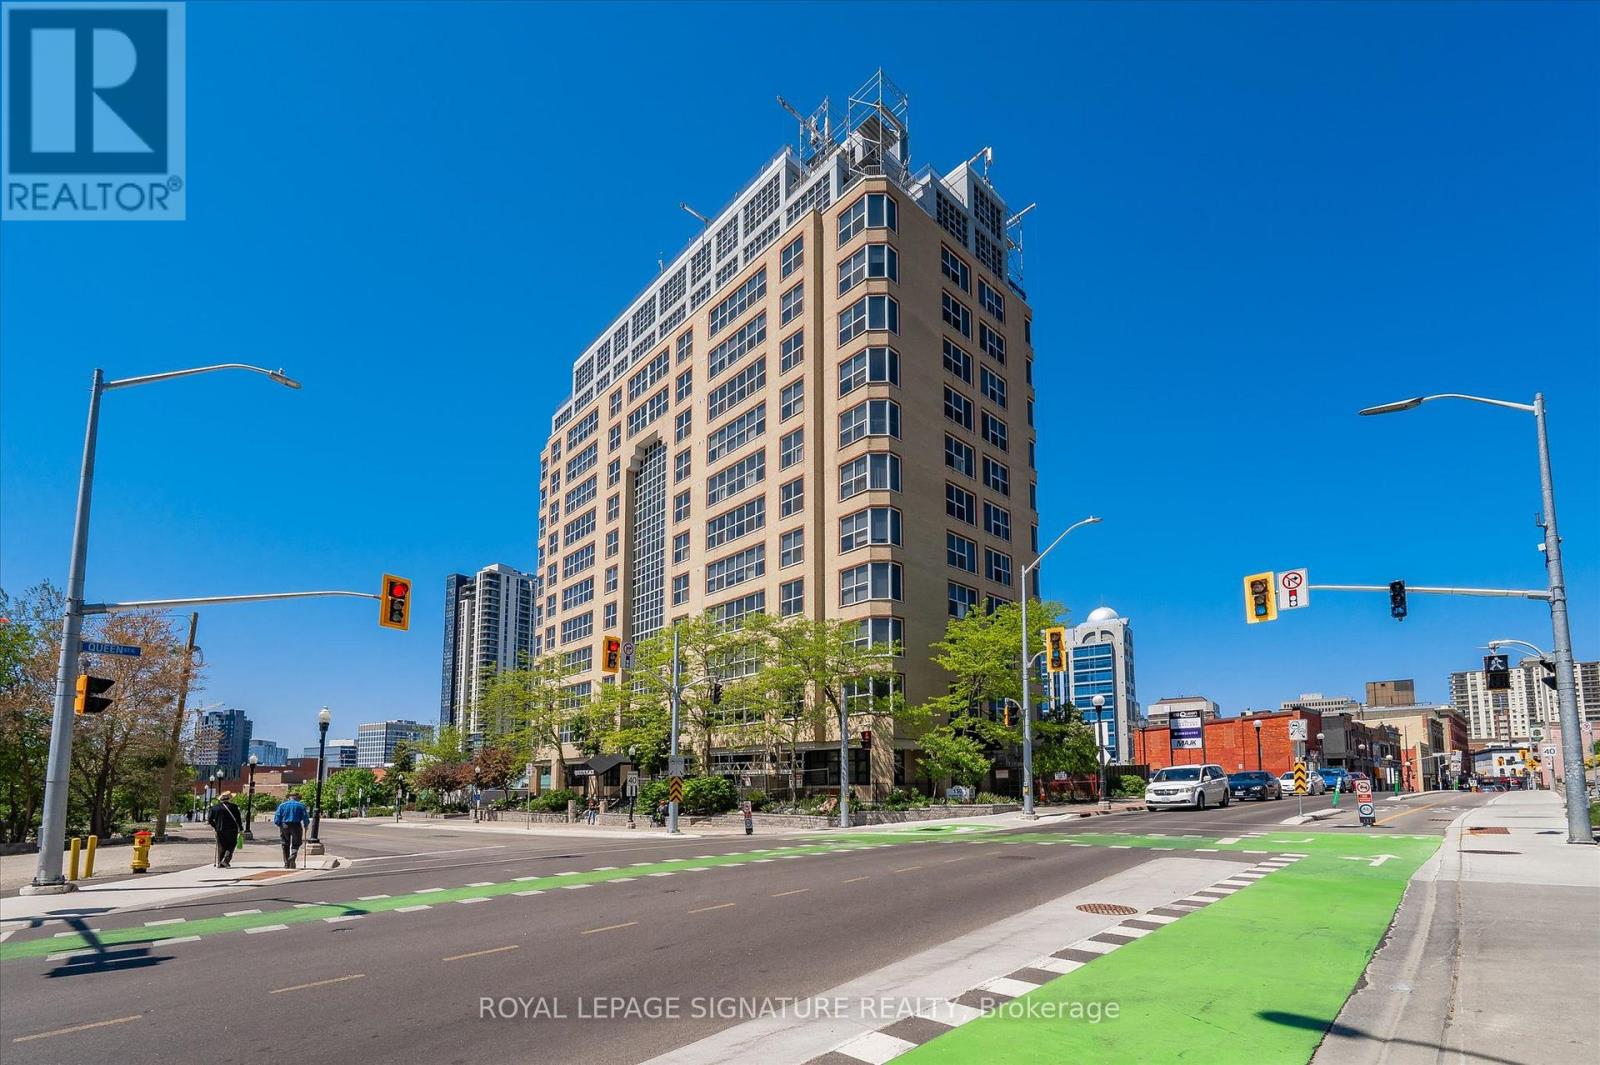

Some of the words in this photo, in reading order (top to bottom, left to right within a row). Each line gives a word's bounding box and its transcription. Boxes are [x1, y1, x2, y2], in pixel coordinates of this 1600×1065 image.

[88, 643, 123, 653] QUEEN
[1176, 739, 1197, 747] MAJK
[628, 776, 637, 784] 40
